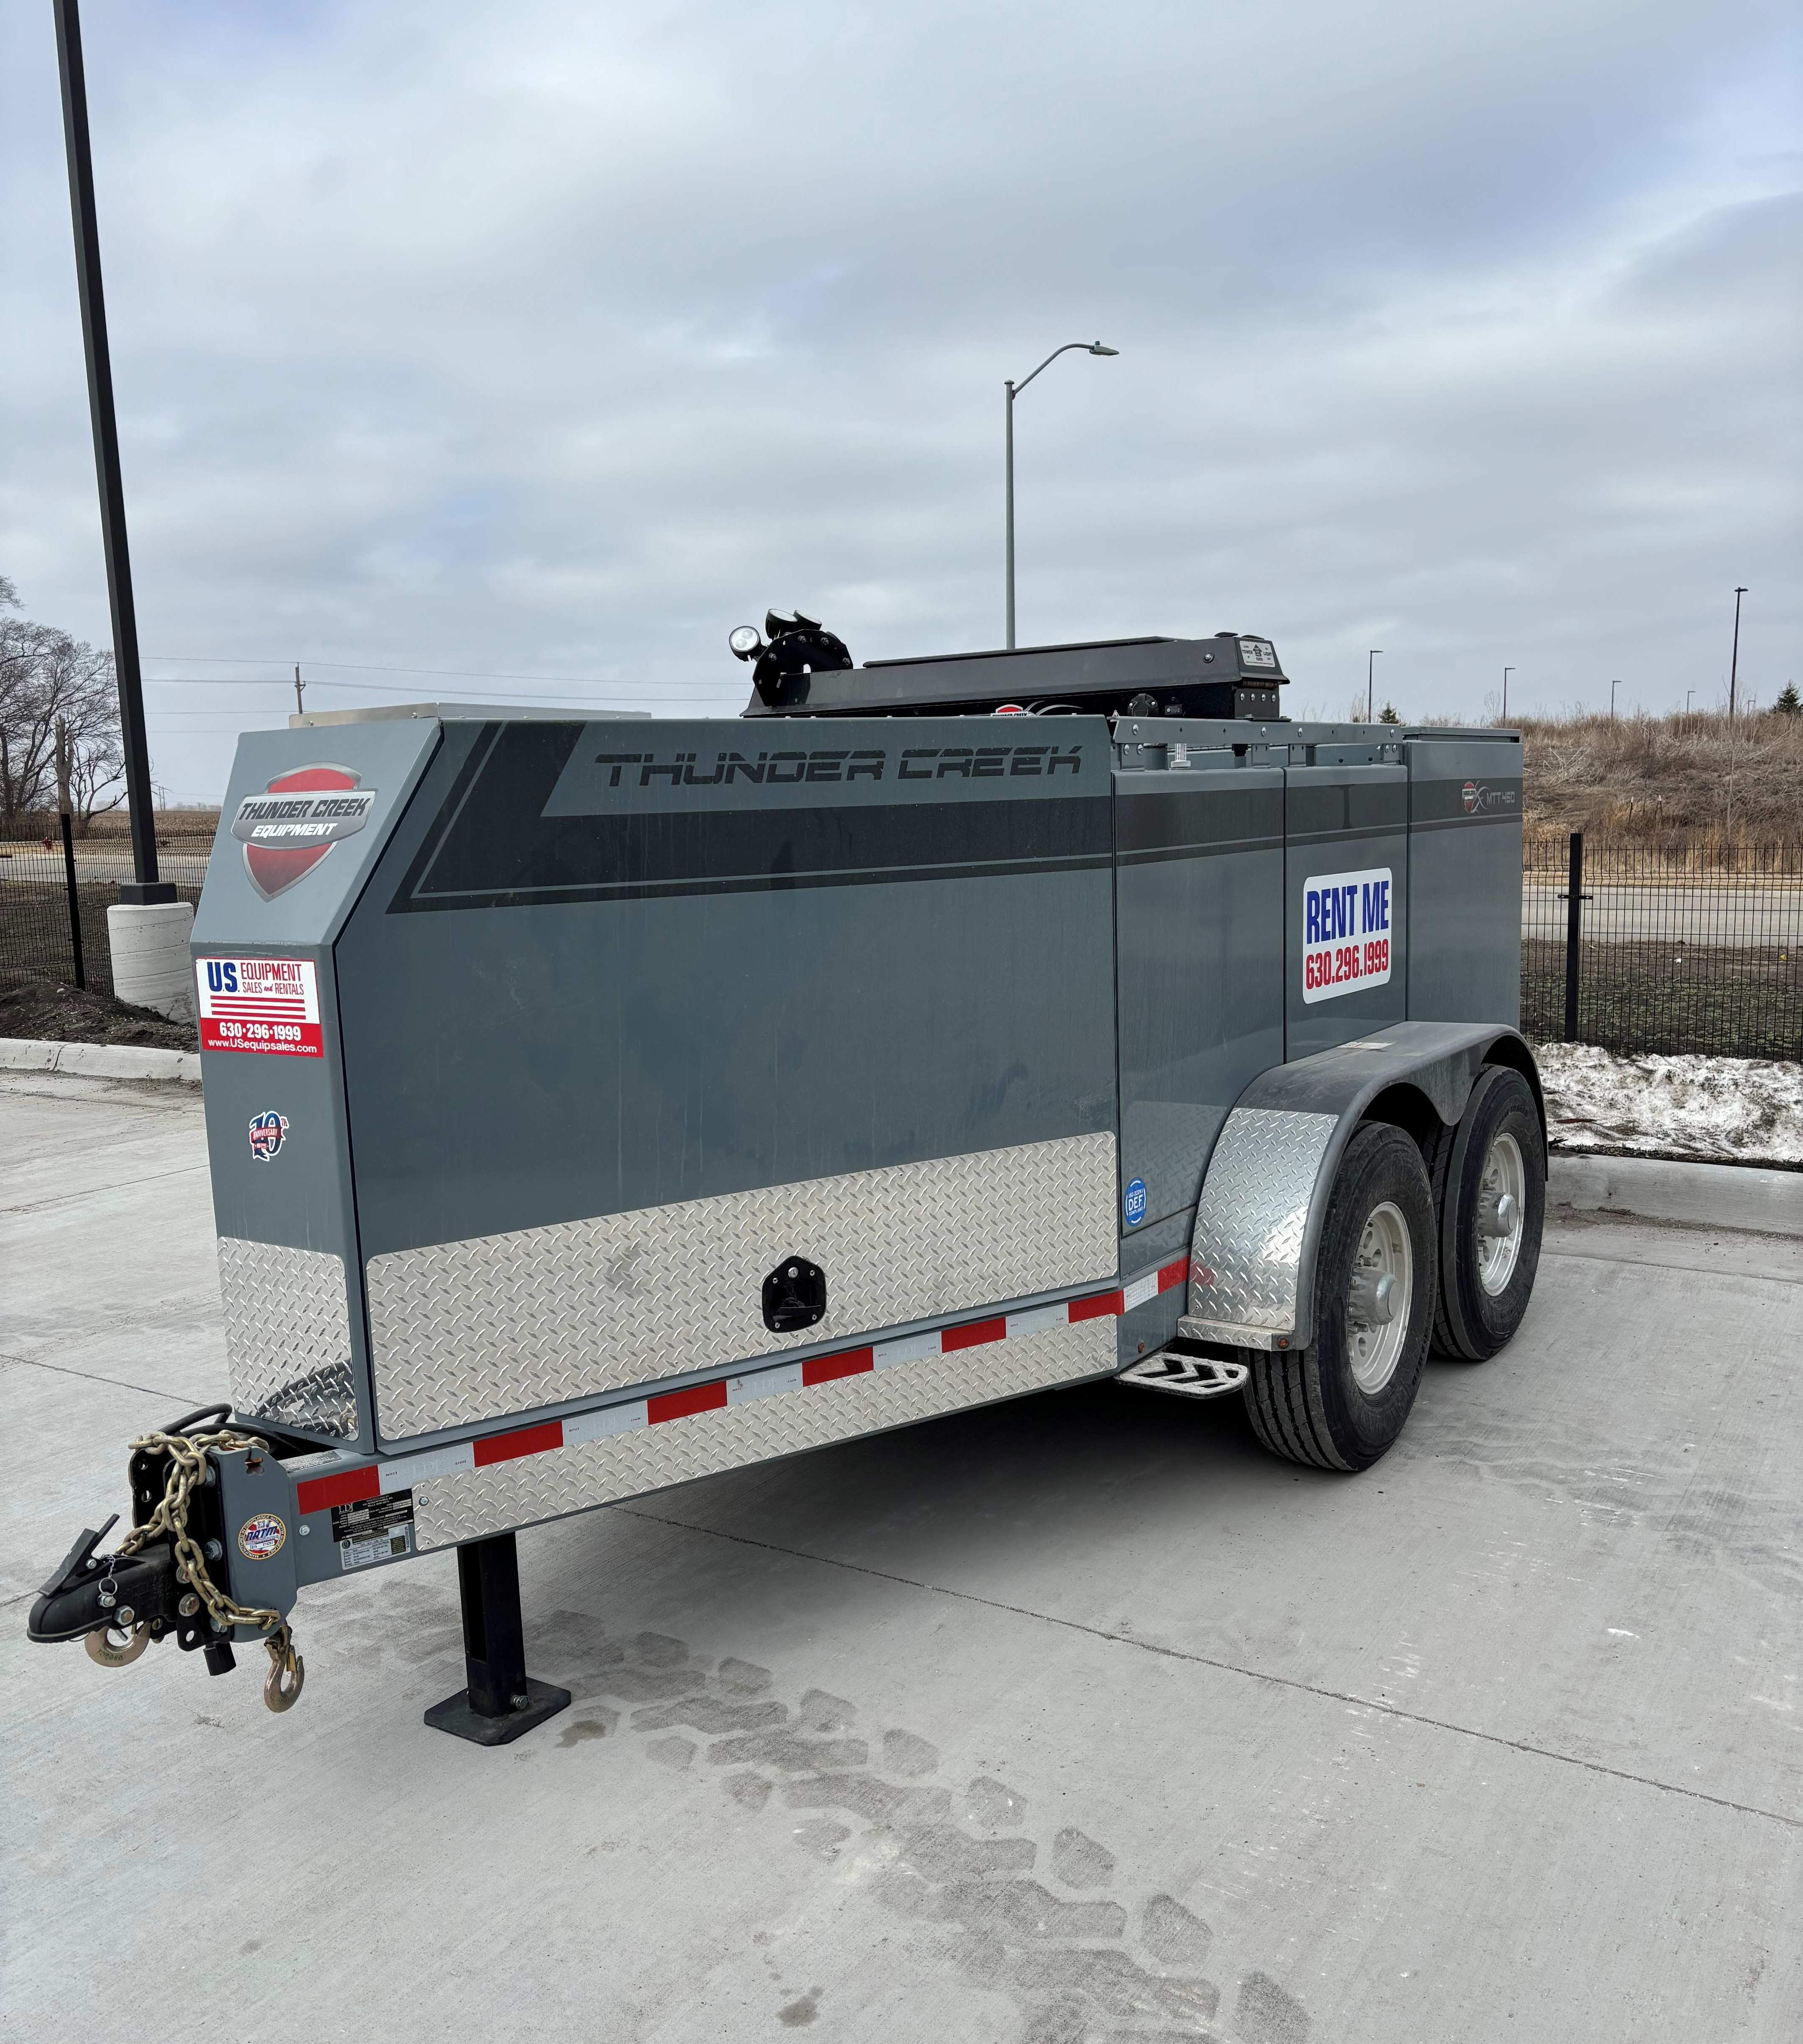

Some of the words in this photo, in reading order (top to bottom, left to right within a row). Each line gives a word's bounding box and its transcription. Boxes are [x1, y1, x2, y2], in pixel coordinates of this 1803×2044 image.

[596, 750, 886, 787] THUNDER
[897, 745, 1083, 779] CREEK
[238, 800, 314, 820] THUNDER
[311, 798, 371, 818] CREEK
[251, 822, 338, 839] EQUIPMENT
[1306, 885, 1358, 945] RENT
[1362, 880, 1389, 934] ME
[240, 962, 302, 981] EQUIPMENT
[1306, 938, 1389, 990] 630.296.1999
[242, 982, 263, 994] SALES
[264, 983, 273, 992] and
[275, 983, 304, 995] RENTALS
[207, 1038, 317, 1053] www.USequipsales.com
[1129, 1194, 1143, 1211] DEF
[339, 1503, 353, 1514] LDJ
[245, 1526, 278, 1542] NATM
